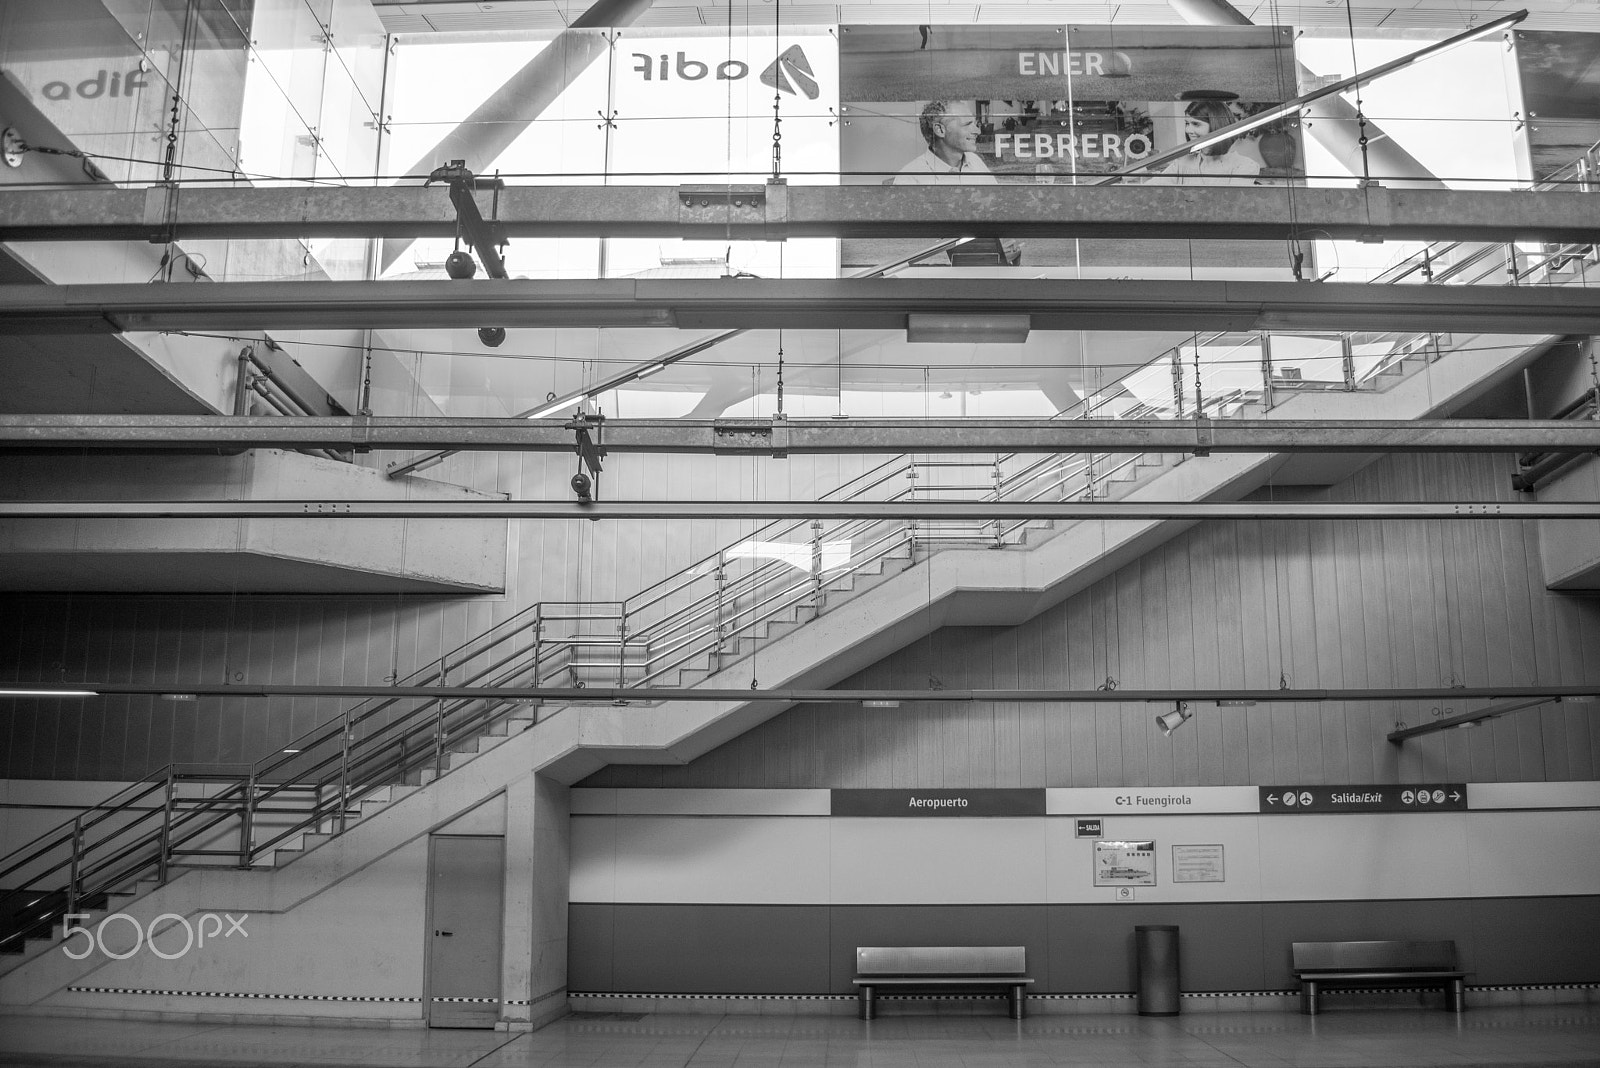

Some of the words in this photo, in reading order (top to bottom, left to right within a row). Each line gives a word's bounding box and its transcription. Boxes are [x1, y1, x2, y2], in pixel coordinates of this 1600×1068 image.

[42, 69, 152, 101] adif
[994, 133, 1152, 160] FEBRERO
[908, 796, 968, 809] Aeropuerto
[1115, 796, 1132, 806] C-1
[1136, 795, 1192, 807] Fuengirola
[1331, 792, 1383, 804] Salida/Exit
